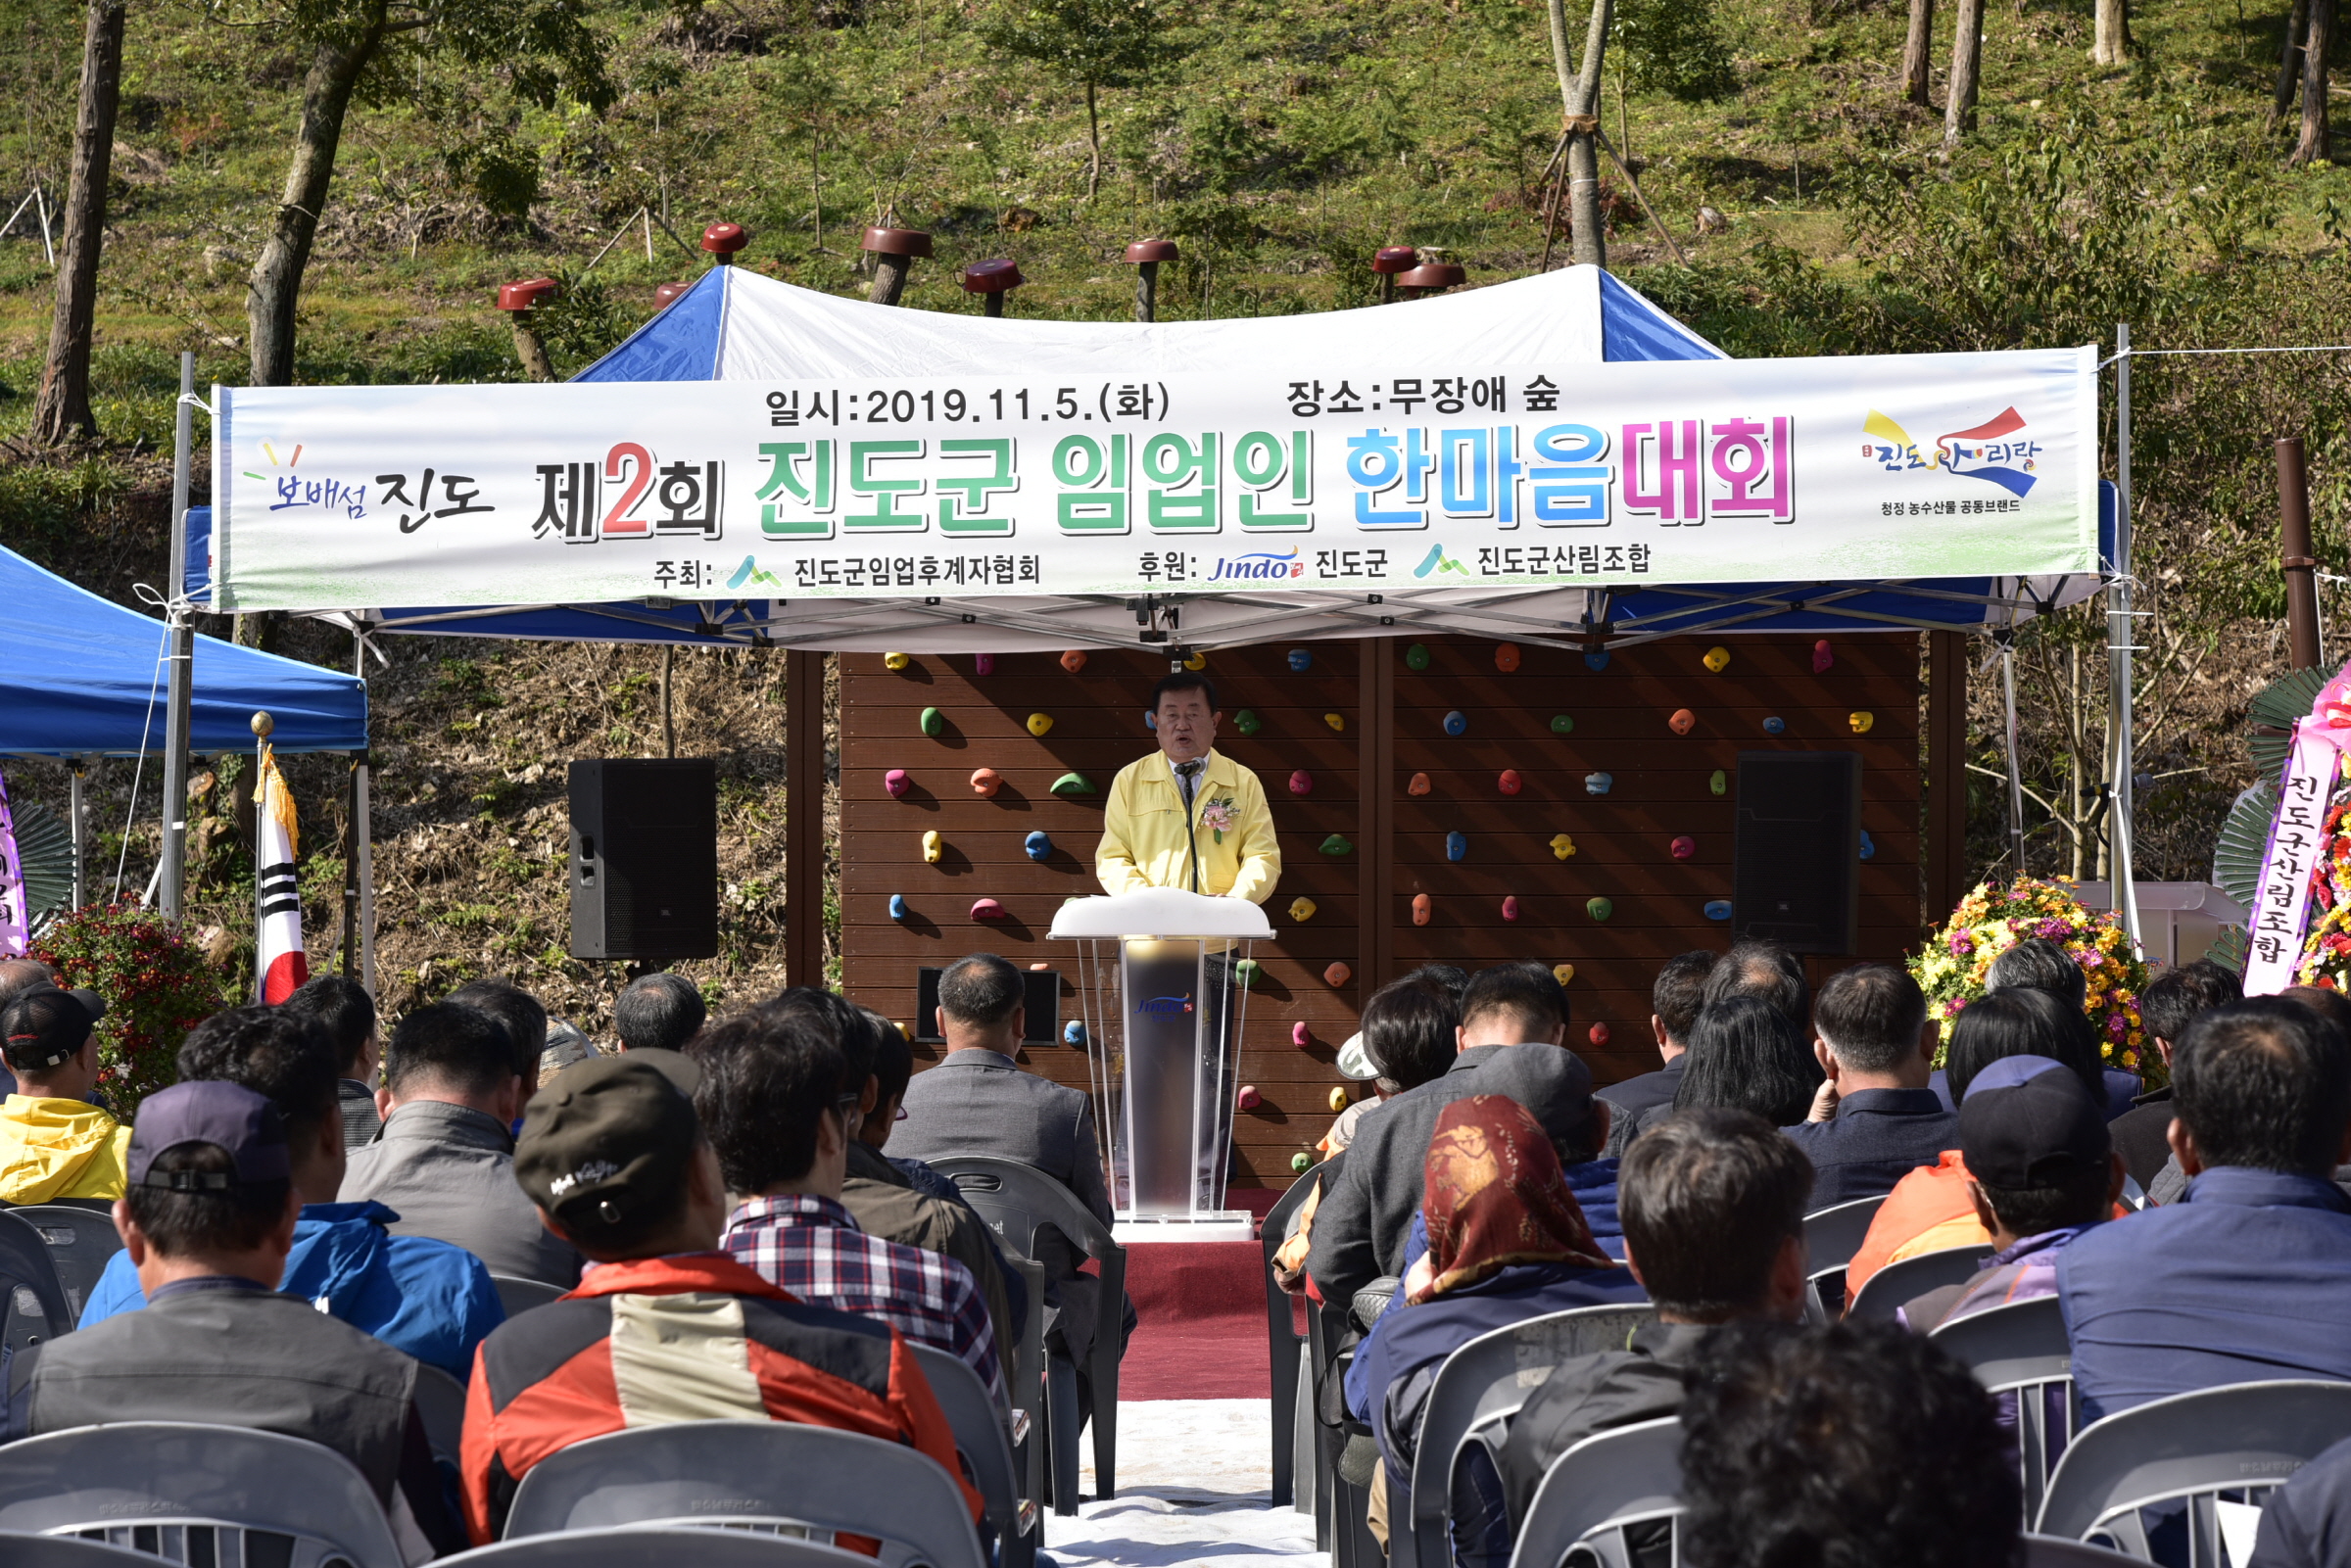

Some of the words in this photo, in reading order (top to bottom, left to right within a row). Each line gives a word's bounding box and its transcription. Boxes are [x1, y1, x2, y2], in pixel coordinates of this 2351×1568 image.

[767, 382, 1168, 426] 일시:2019.11.5.(화)
[1287, 376, 1507, 416] 장소:무장애
[1523, 375, 1559, 411] 숲
[269, 476, 366, 519] 보배섬
[376, 468, 495, 533] 진도
[532, 443, 725, 544] 제2회
[755, 438, 1020, 541] 진도군
[1052, 431, 1314, 537] 임업인
[1881, 501, 1904, 515] 청정
[1908, 500, 1957, 515] 농수산물
[1960, 499, 2021, 514] 공동브랜드
[654, 560, 713, 588] 주최:
[794, 555, 1039, 587] 진도군임업후계자협회
[1138, 552, 1197, 581] 후원:
[1207, 557, 1287, 581] Jindo
[1317, 549, 1388, 578] 진도군
[1478, 545, 1652, 575] 진도군산림조합
[2255, 775, 2319, 965] 진도군산림조합
[1133, 999, 1183, 1014] Jindo
